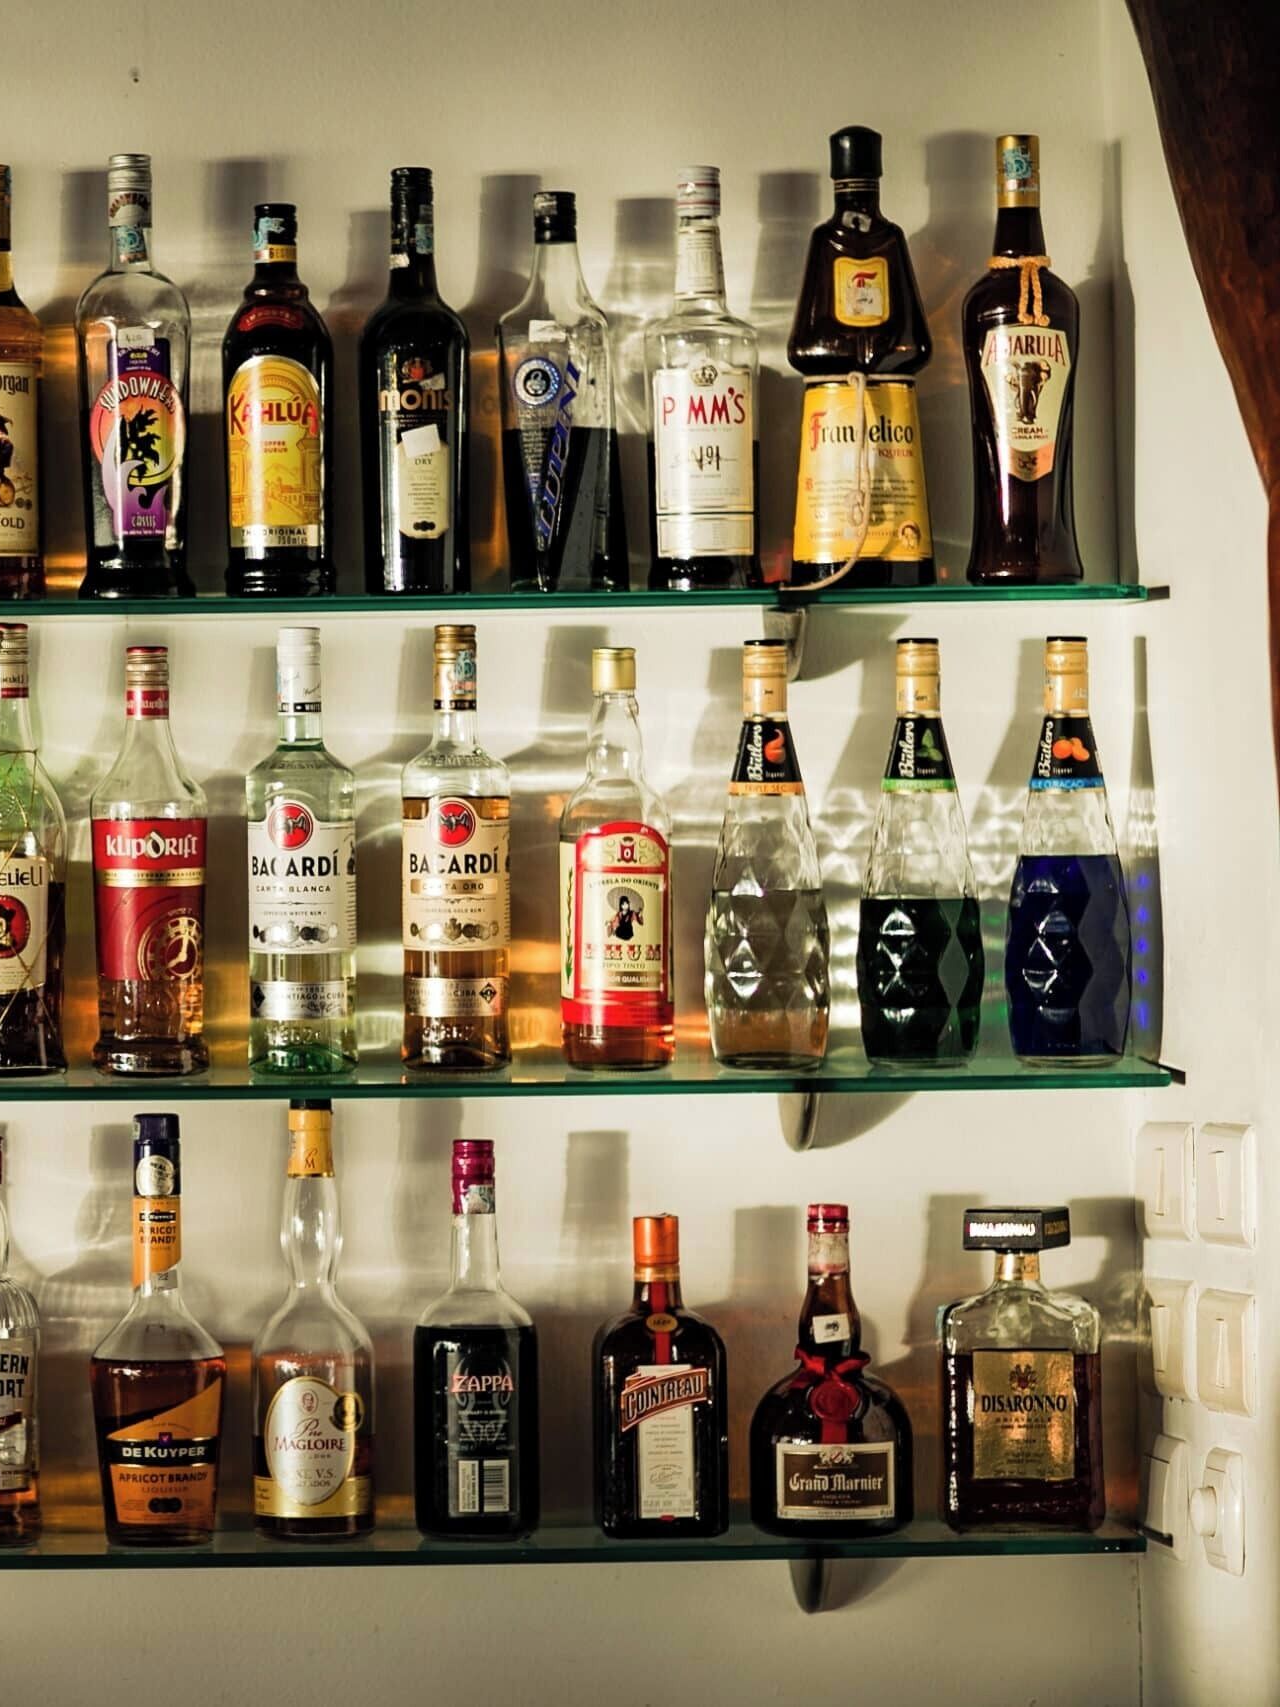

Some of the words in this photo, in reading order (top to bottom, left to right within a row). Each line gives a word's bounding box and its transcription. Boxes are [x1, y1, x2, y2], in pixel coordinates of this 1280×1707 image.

[229, 389, 319, 437] KAHLÚA
[663, 386, 746, 426] PMM'S
[810, 411, 914, 450] Franelico
[873, 449, 913, 459] IQUEUR
[287, 885, 331, 893] BLANCA
[462, 882, 484, 890] ORO
[139, 1226, 176, 1235] ARICOT
[140, 1236, 176, 1244] BANDY
[450, 1374, 515, 1393] ZAPPA
[625, 1374, 706, 1423] COINTREAU
[981, 1393, 1068, 1414] DISARONNO
[122, 1446, 142, 1457] DE
[144, 1445, 206, 1458] KUYPER
[273, 1435, 347, 1452] MAGLOIRE
[119, 1472, 167, 1483] APRICOT
[789, 1472, 830, 1492] Grand
[830, 1472, 884, 1492] Marnier
